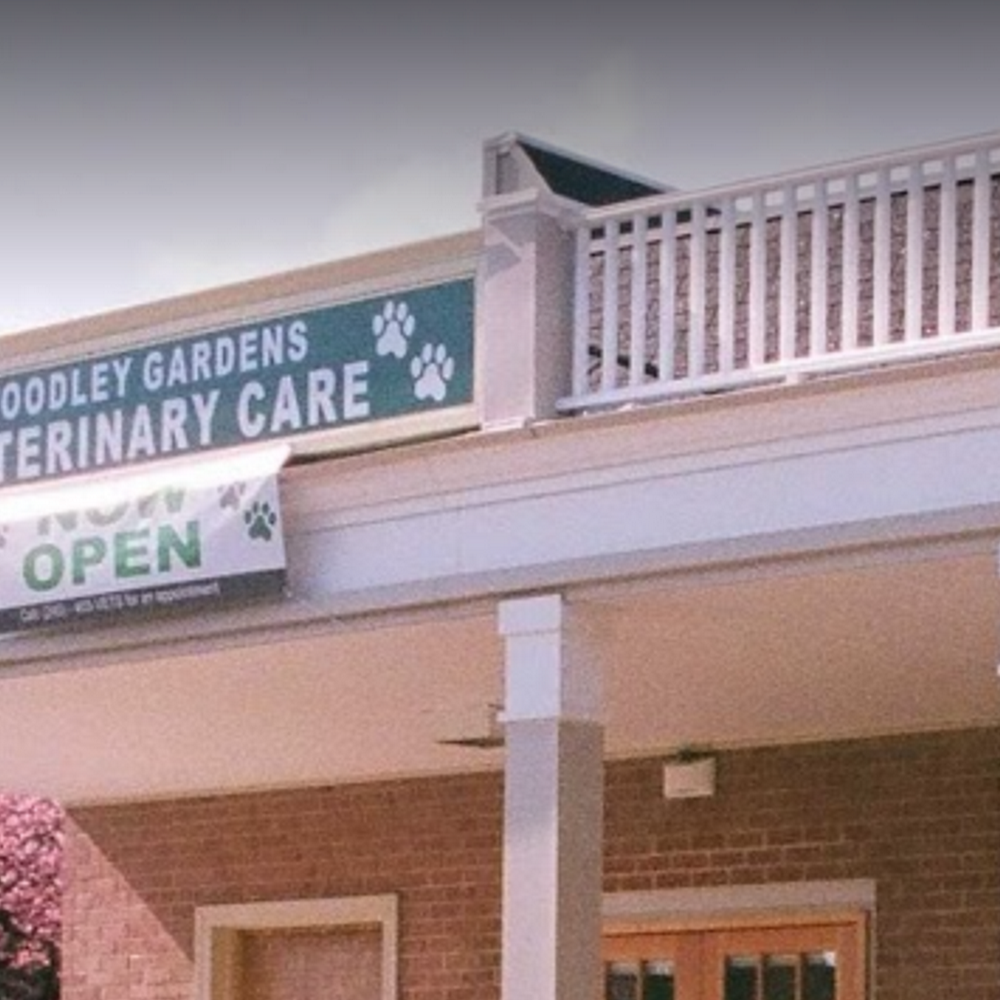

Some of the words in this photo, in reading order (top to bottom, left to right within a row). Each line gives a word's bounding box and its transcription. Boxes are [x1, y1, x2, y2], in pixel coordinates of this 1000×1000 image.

[142, 320, 309, 392] GARDENS
[237, 360, 371, 438] CARE
[22, 519, 202, 592] OPEN
